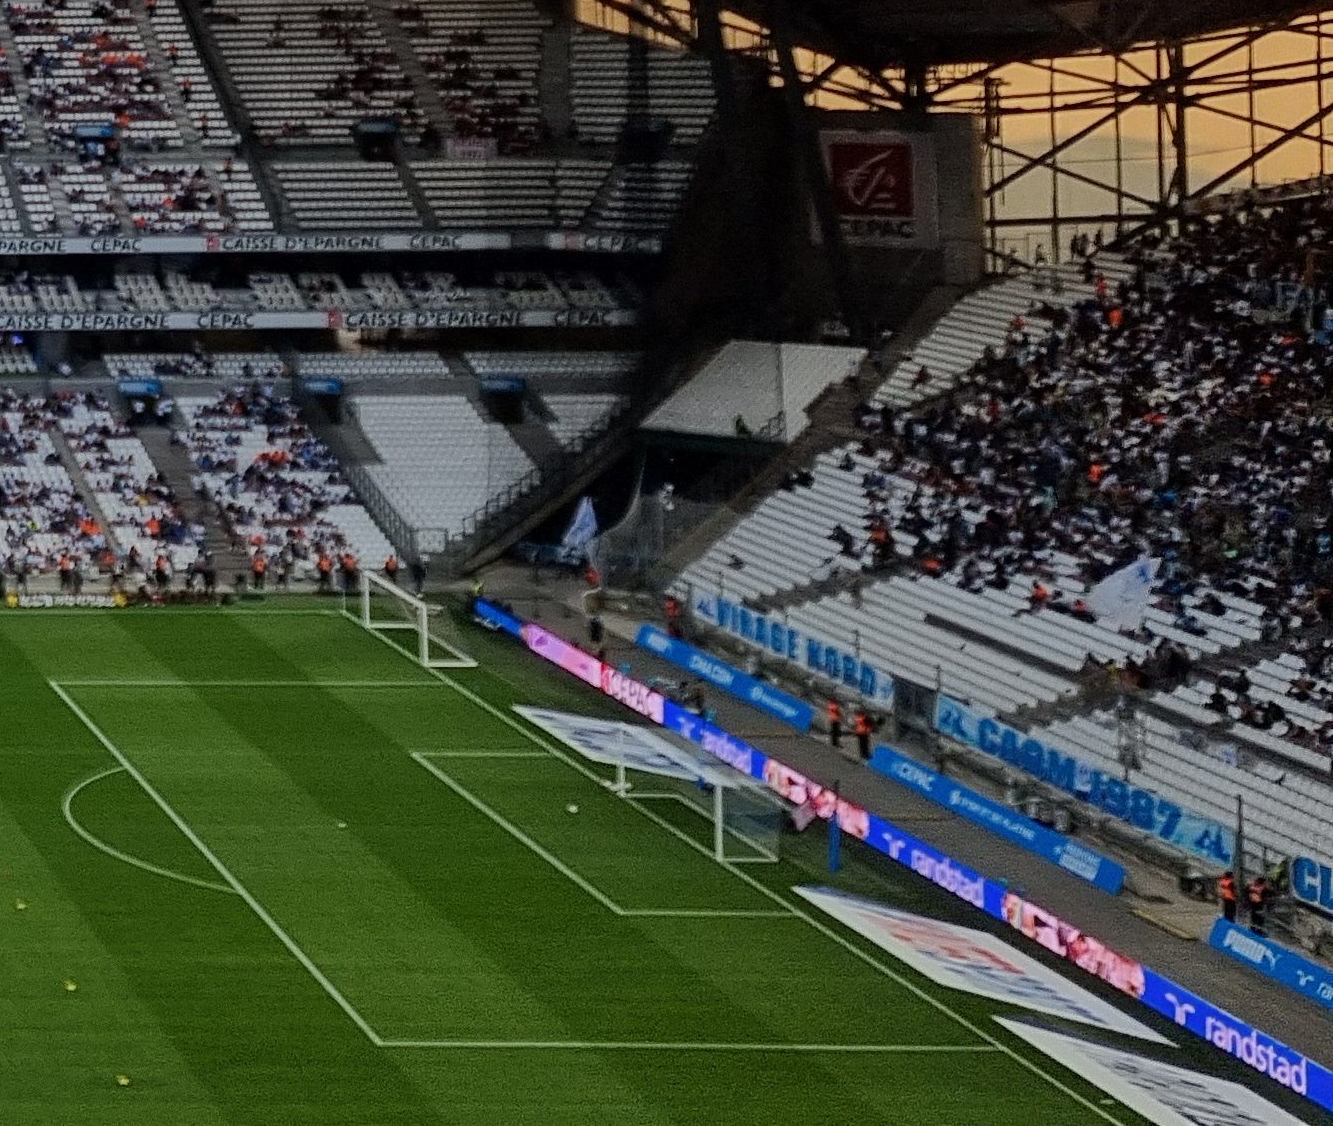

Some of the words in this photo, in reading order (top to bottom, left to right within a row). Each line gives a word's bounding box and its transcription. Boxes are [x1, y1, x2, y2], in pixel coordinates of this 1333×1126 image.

[90, 238, 141, 252] CEPAC
[60, 315, 170, 329] D'EPARGNE
[197, 314, 255, 327] CEPAC
[718, 599, 796, 659] VIRAGE
[808, 638, 875, 696] NORD
[910, 848, 984, 908] randstad
[1204, 1014, 1307, 1095] randstad
